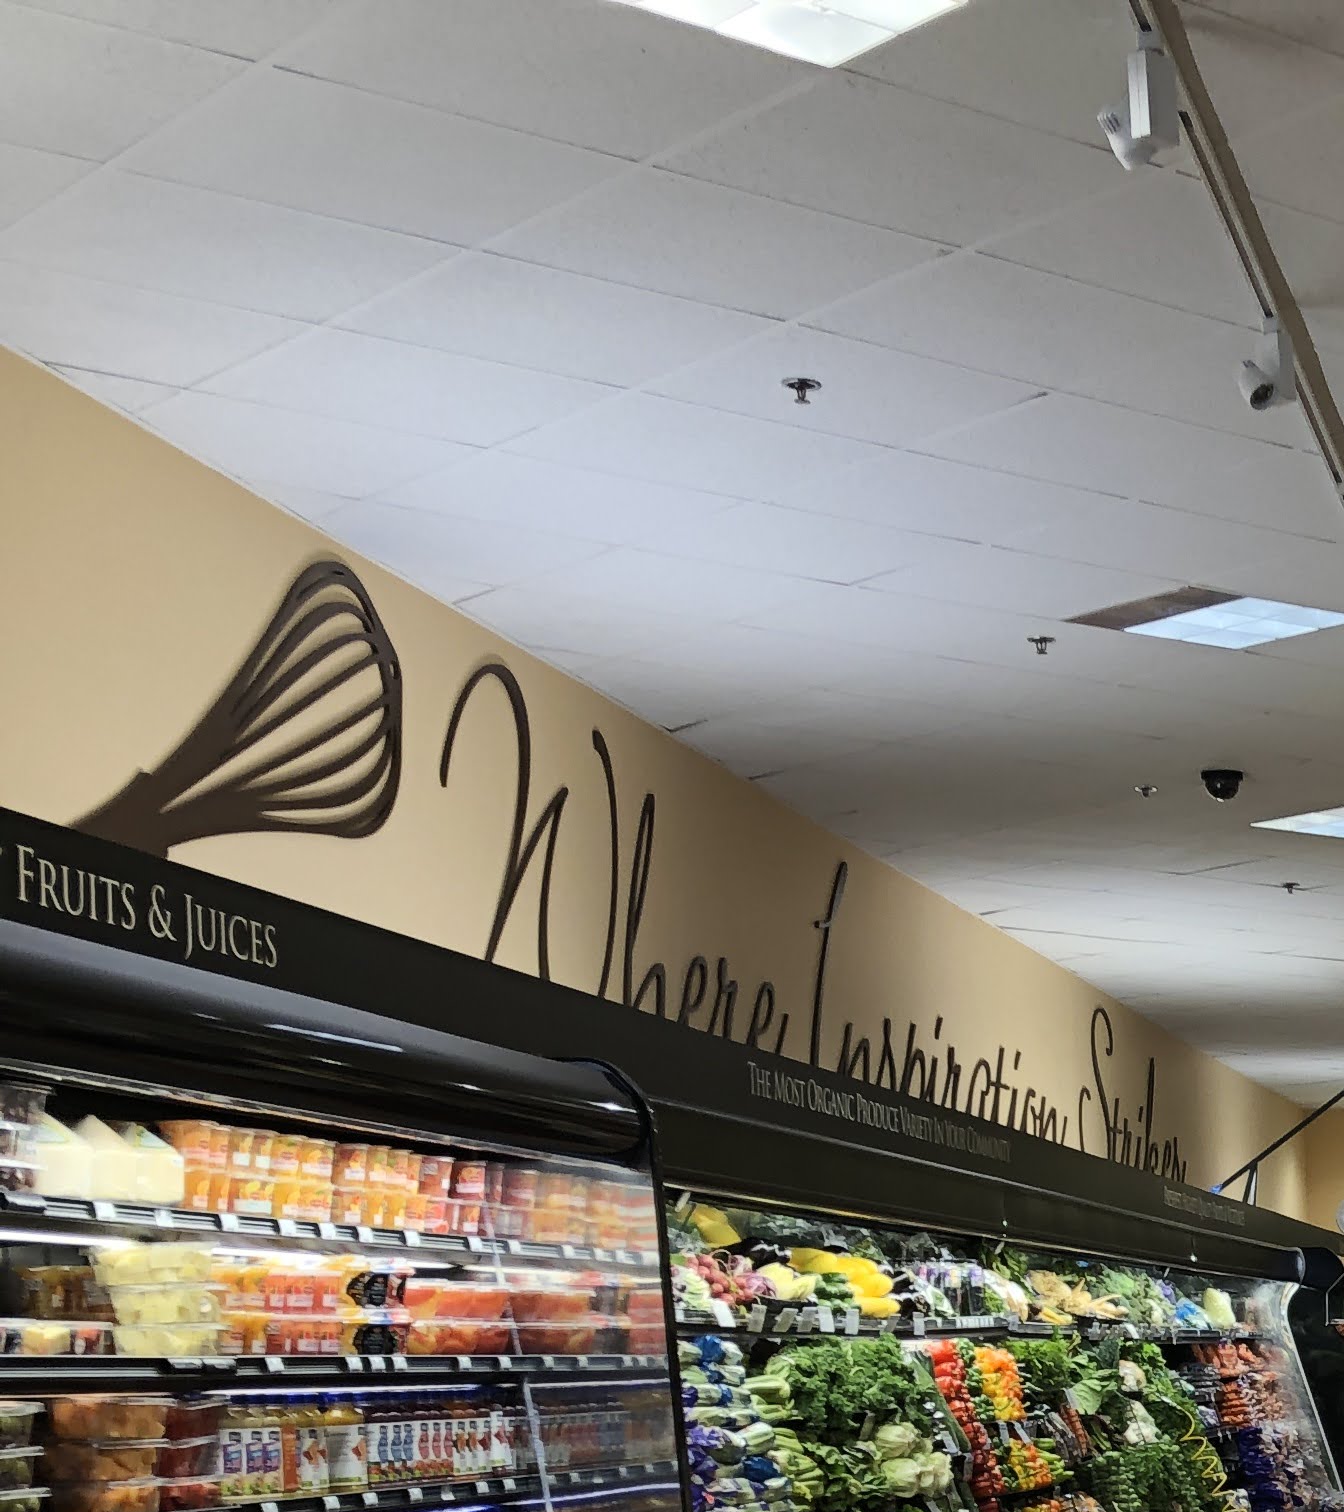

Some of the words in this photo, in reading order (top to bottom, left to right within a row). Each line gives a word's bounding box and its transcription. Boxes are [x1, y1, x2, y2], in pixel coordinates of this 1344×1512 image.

[15, 843, 137, 931] FRUITS
[148, 884, 178, 943] &
[183, 893, 279, 969] JUICES
[747, 1061, 772, 1097] THE
[774, 1072, 805, 1108] MOST
[806, 1079, 856, 1122] ORGANIC
[857, 1092, 900, 1133] PRODUCE
